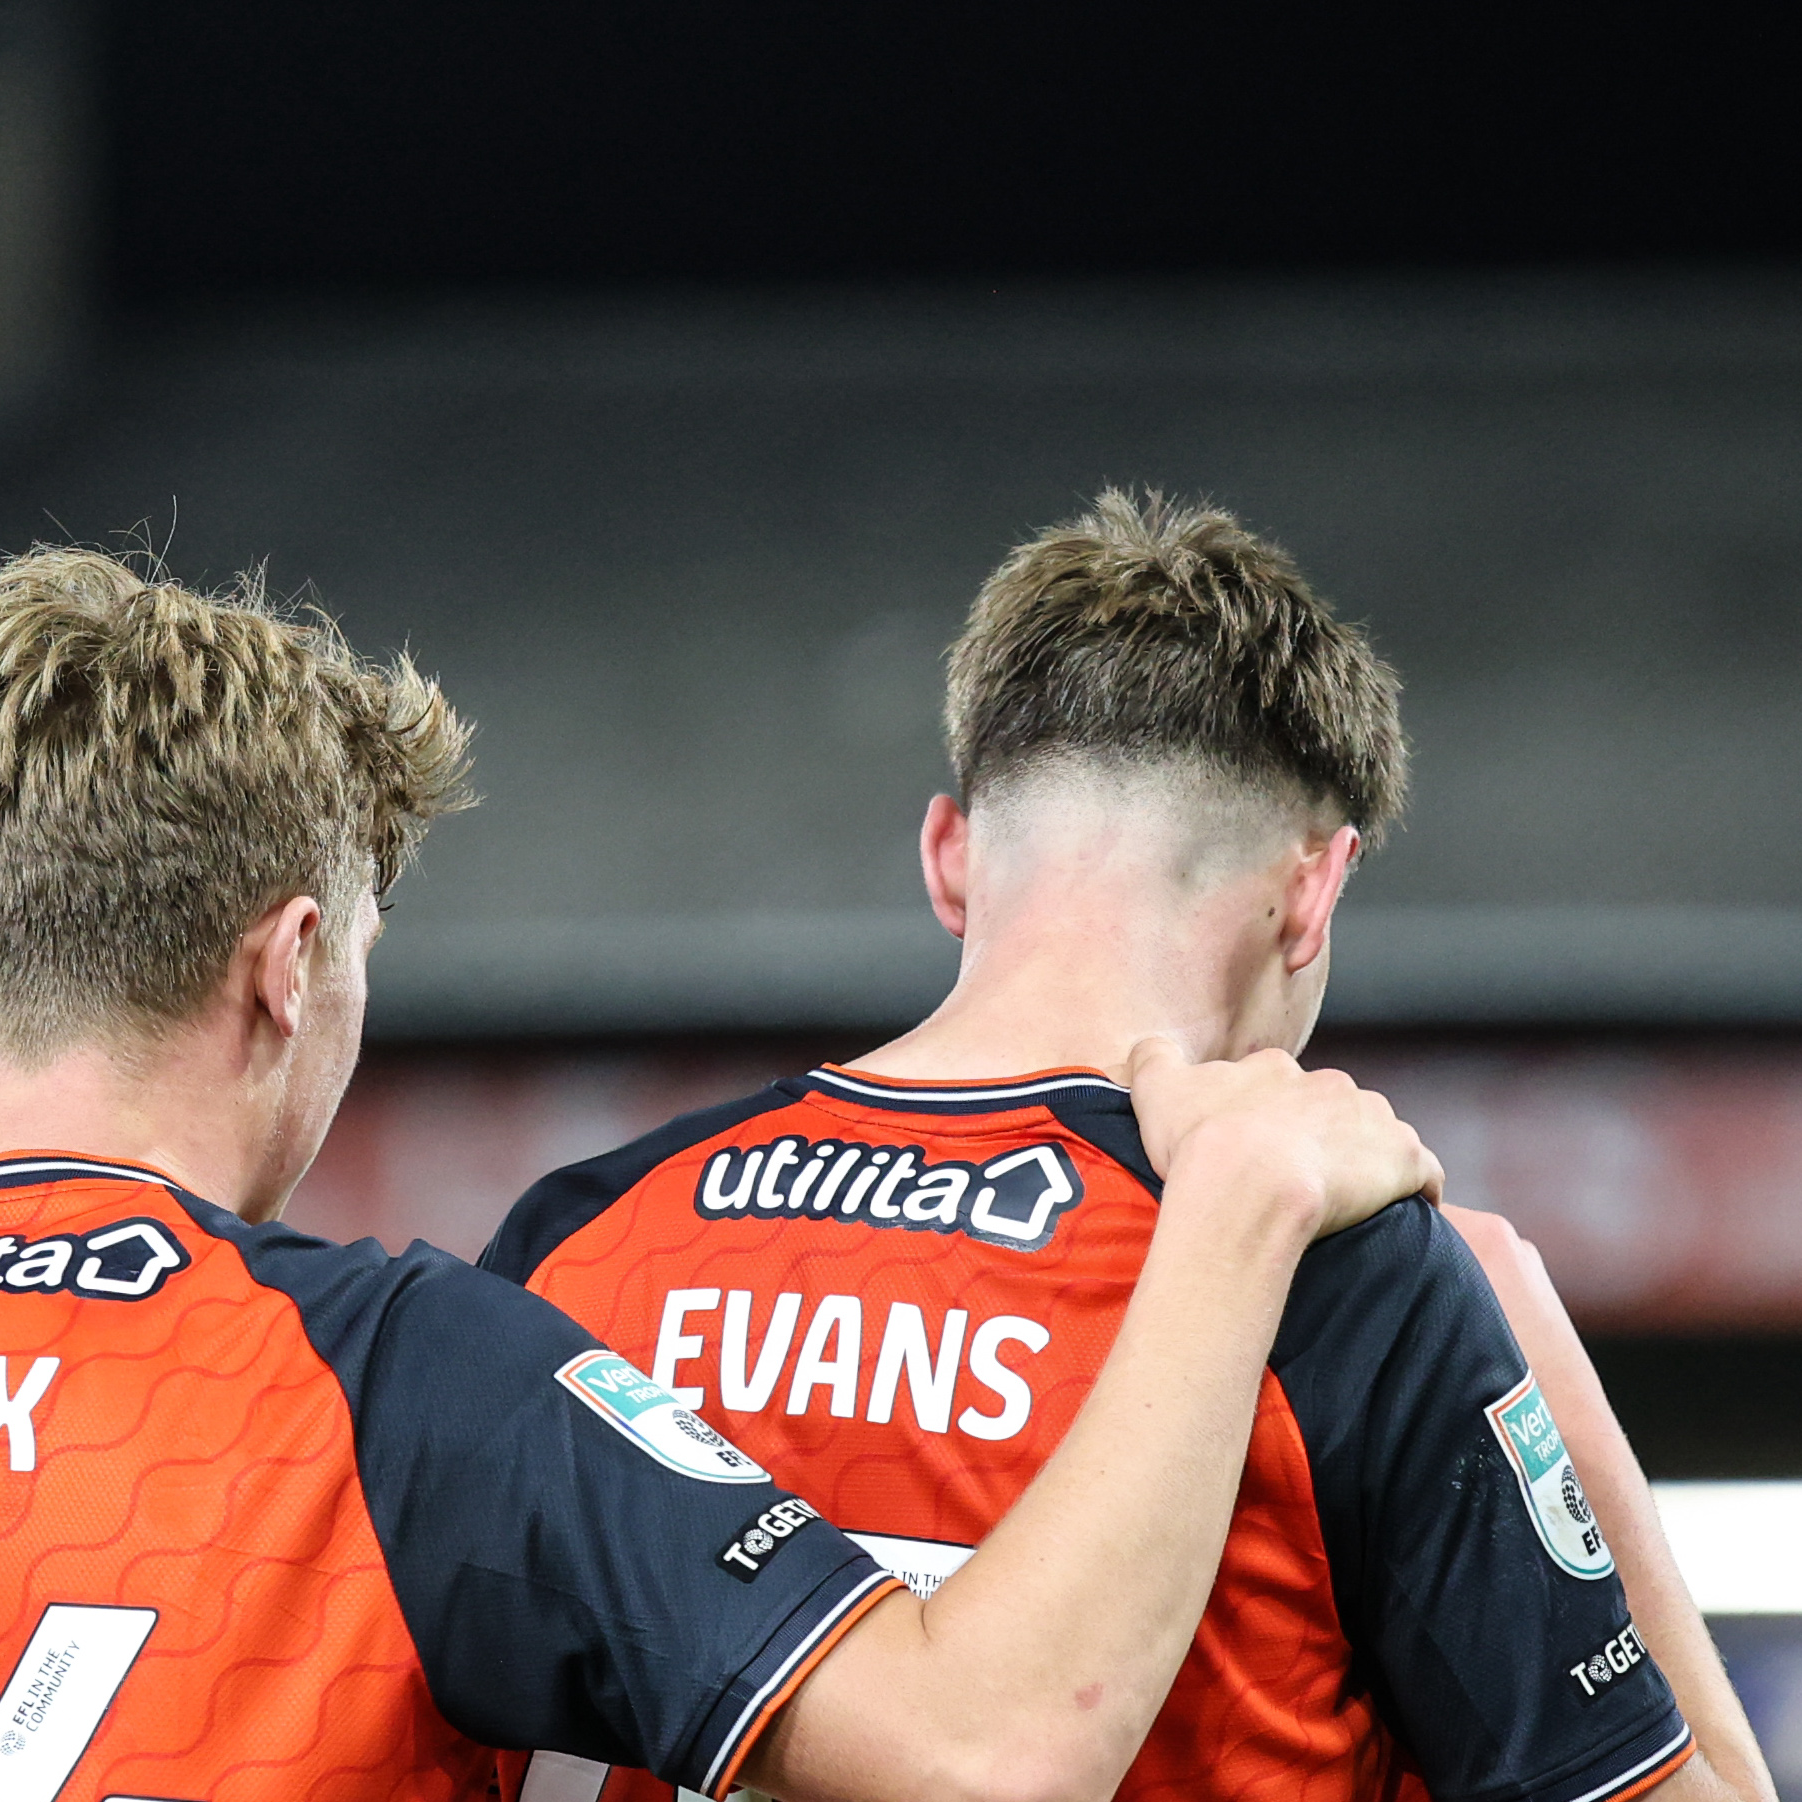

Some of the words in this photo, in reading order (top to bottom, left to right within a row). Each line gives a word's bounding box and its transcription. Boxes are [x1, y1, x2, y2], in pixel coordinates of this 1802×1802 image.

[702, 1139, 970, 1225] utilita
[651, 1287, 1052, 1441] EVANS
[1533, 1429, 1562, 1462] TROP
[1582, 1525, 1605, 1557] EF
[924, 1573, 943, 1588] TH
[12, 1700, 35, 1725] EFL
[27, 1678, 45, 1698] IN
[38, 1648, 61, 1676] THE
[25, 1640, 81, 1732] COMMUNITY
